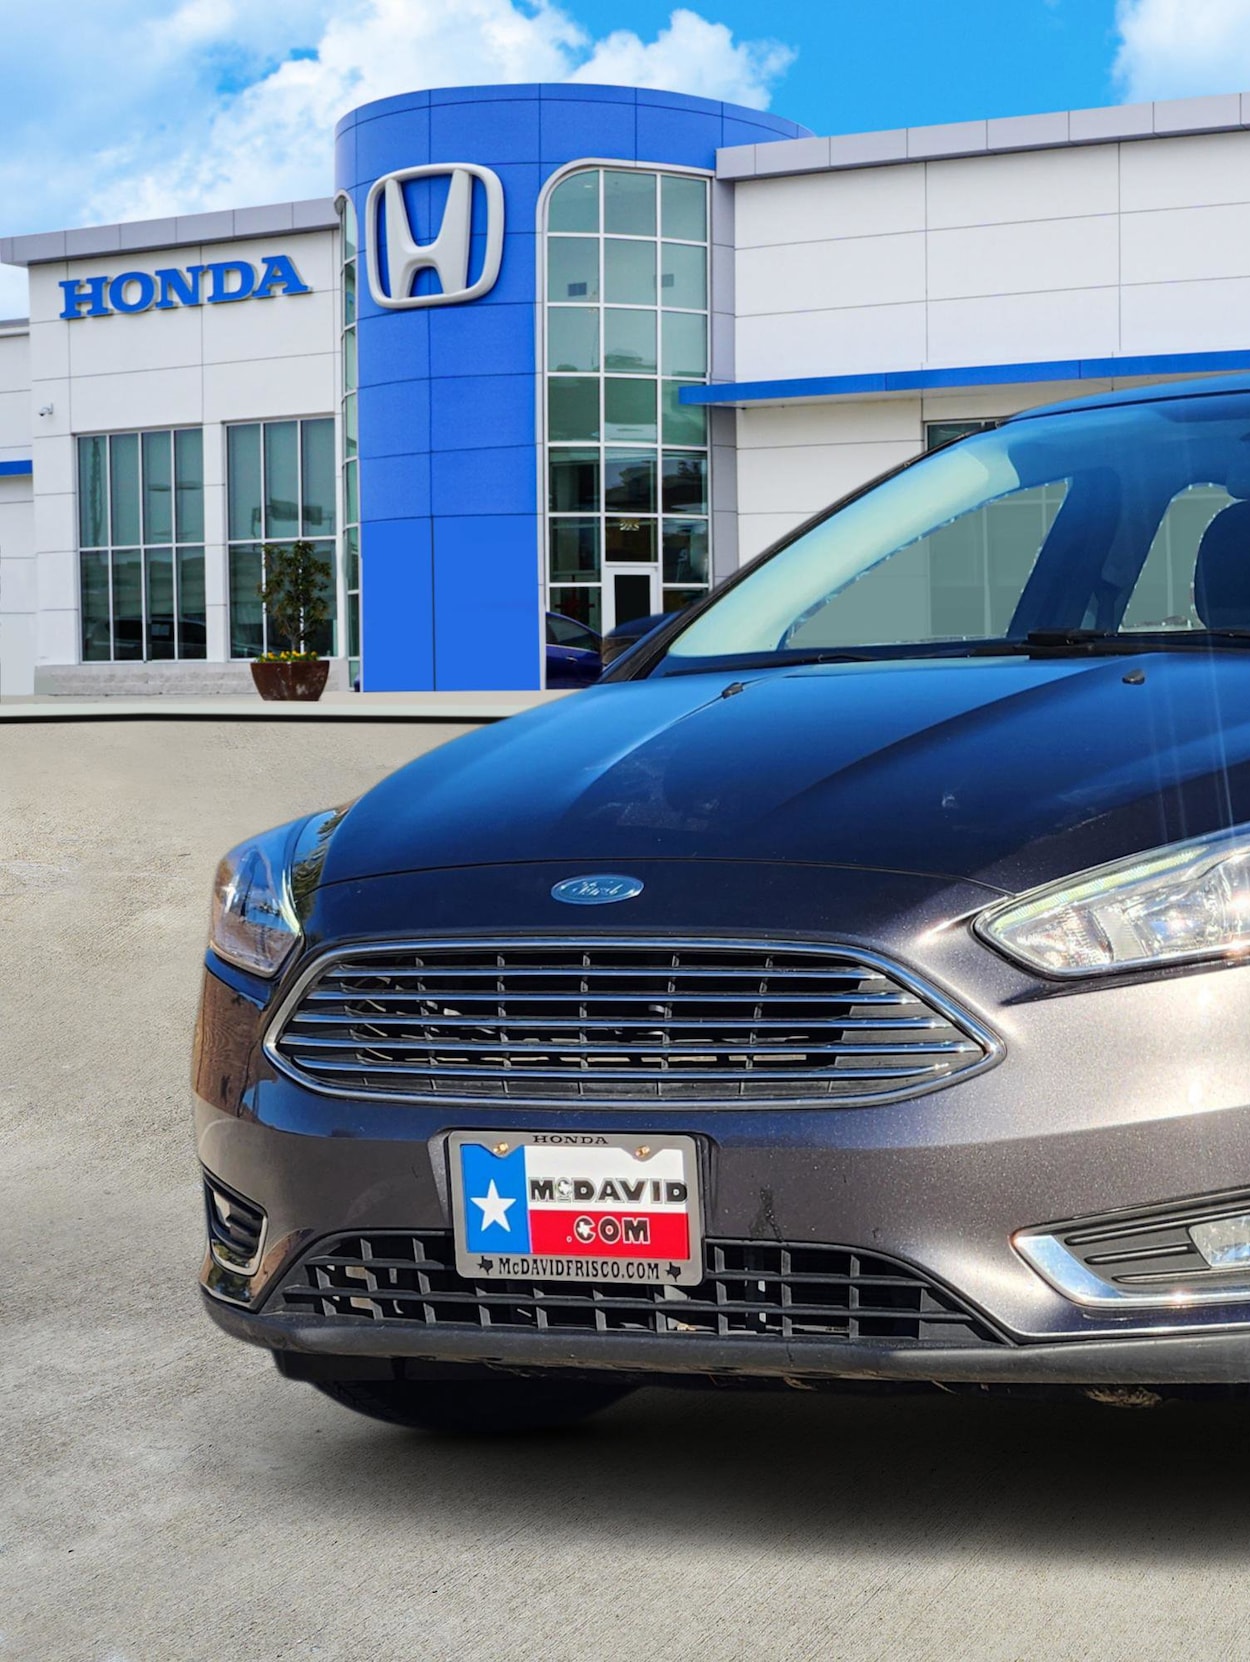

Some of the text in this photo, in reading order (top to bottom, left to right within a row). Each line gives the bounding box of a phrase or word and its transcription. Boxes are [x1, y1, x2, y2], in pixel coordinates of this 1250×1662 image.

[58, 254, 312, 320] HONDA
[532, 1134, 609, 1145] HONDA
[498, 1256, 660, 1280] McDAVIDFRISCO.COM
